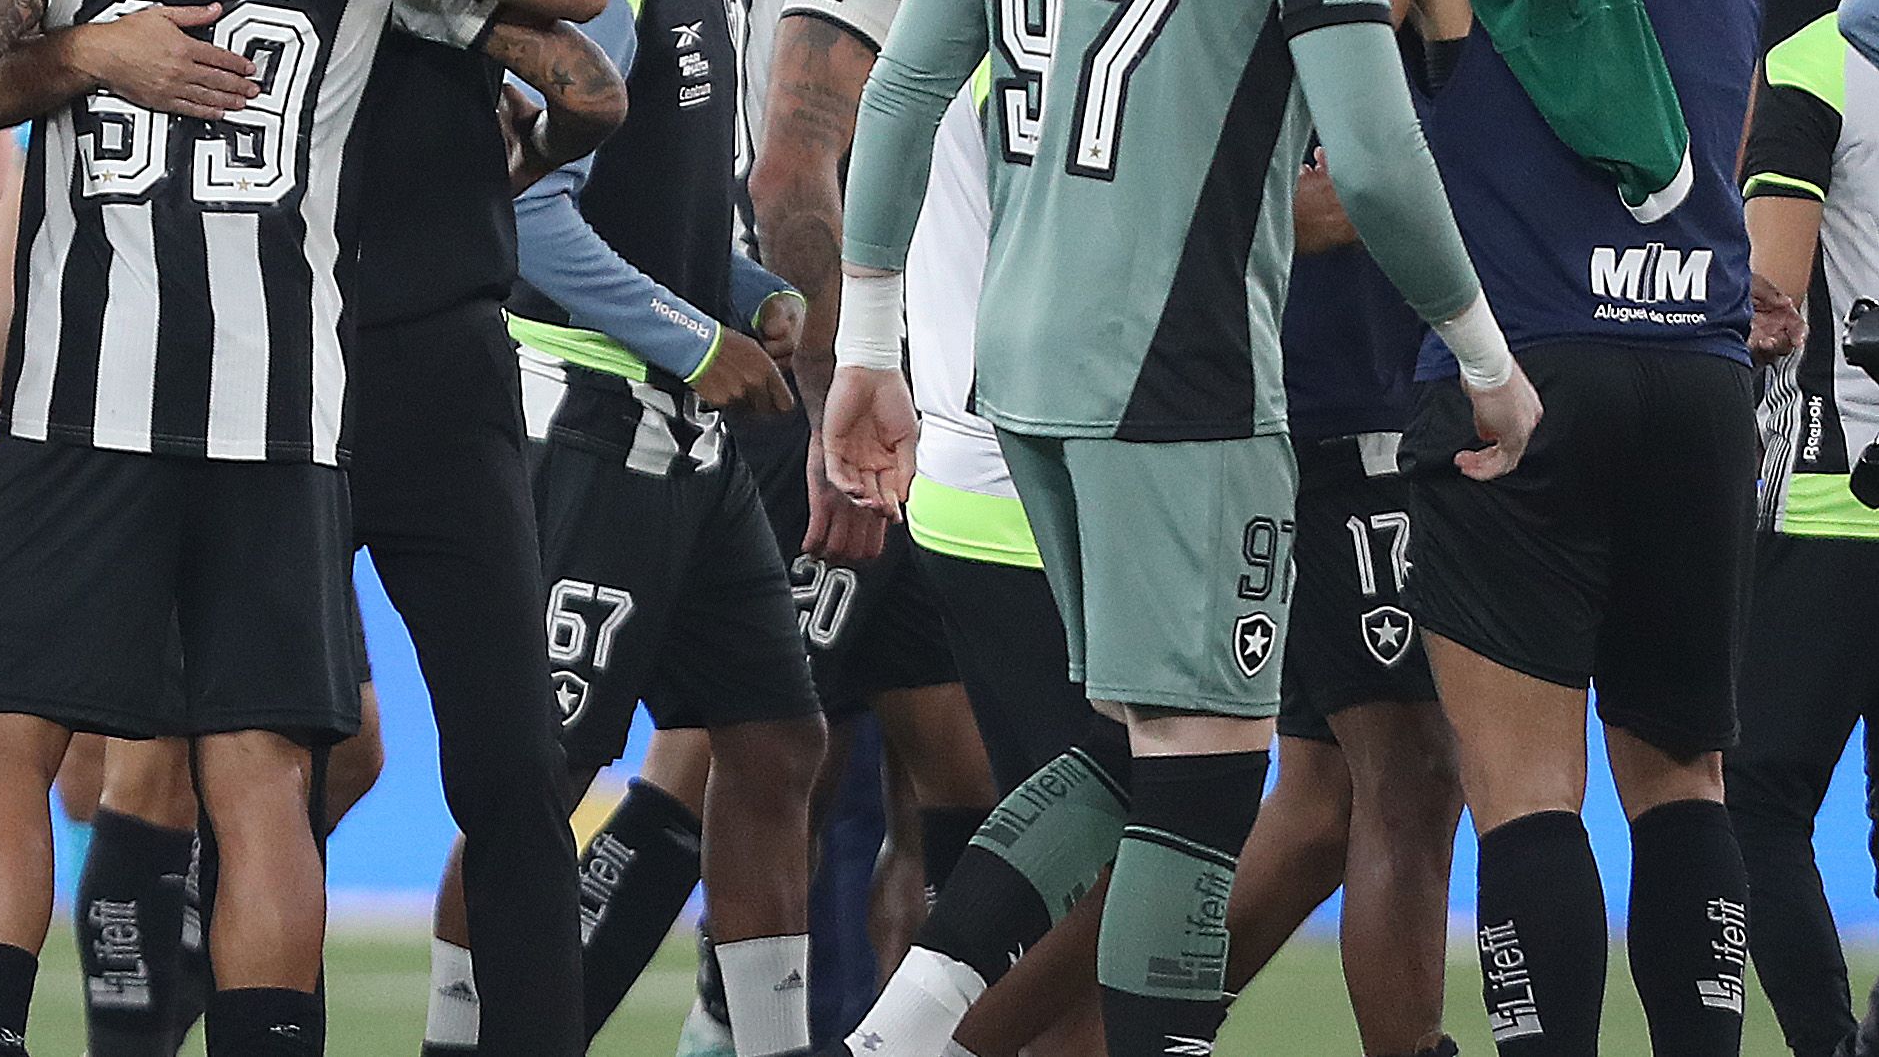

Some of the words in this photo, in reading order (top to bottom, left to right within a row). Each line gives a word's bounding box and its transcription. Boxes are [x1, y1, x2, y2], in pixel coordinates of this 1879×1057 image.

[650, 298, 710, 339] Reebok
[1802, 395, 1823, 460] Reebok
[1346, 511, 1414, 595] 17
[546, 578, 634, 669] 67
[790, 551, 857, 646] 20
[89, 898, 148, 977] Lifefit
[1479, 919, 1536, 1010] Lifefit
[1707, 897, 1748, 987] Lifefit
